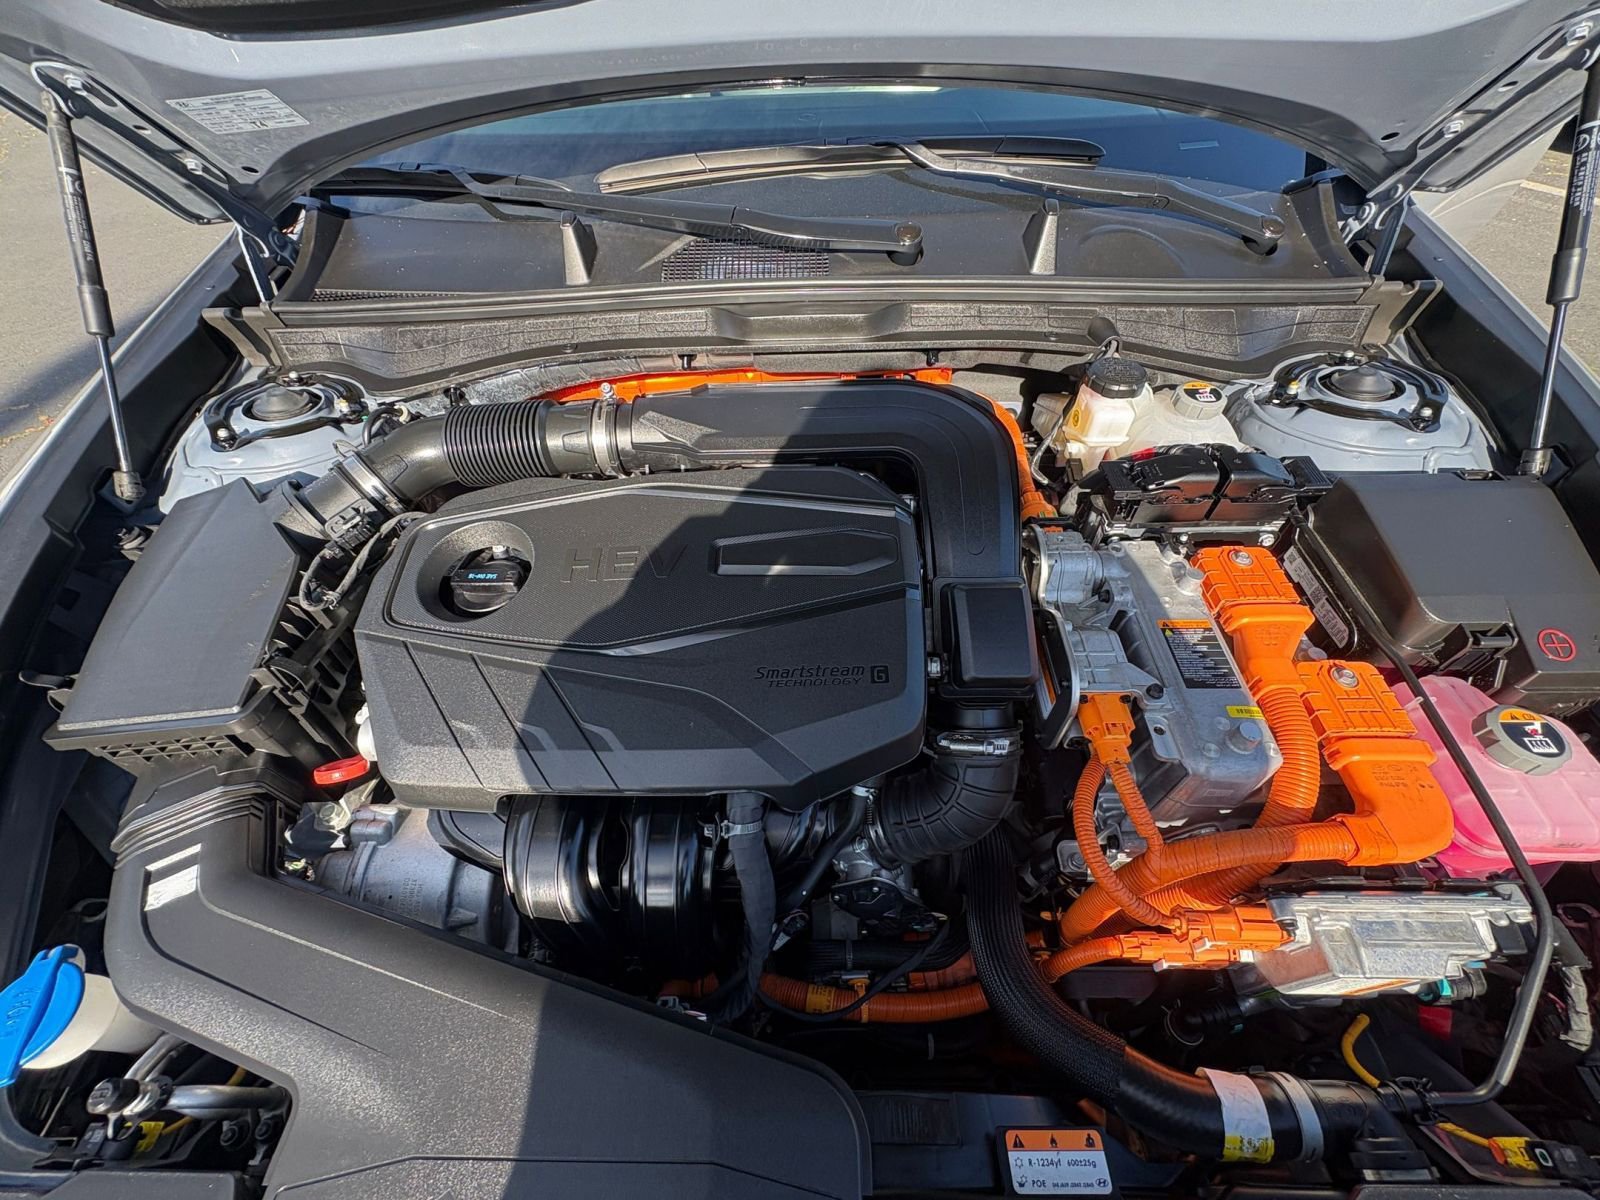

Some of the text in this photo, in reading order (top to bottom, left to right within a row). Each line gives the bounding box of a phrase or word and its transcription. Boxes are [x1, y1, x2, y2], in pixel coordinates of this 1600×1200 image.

[560, 545, 689, 583] HEV
[754, 665, 888, 682] Smartstream G
[767, 677, 862, 688] TECHNOLOGY
[1032, 1180, 1047, 1188] POE
